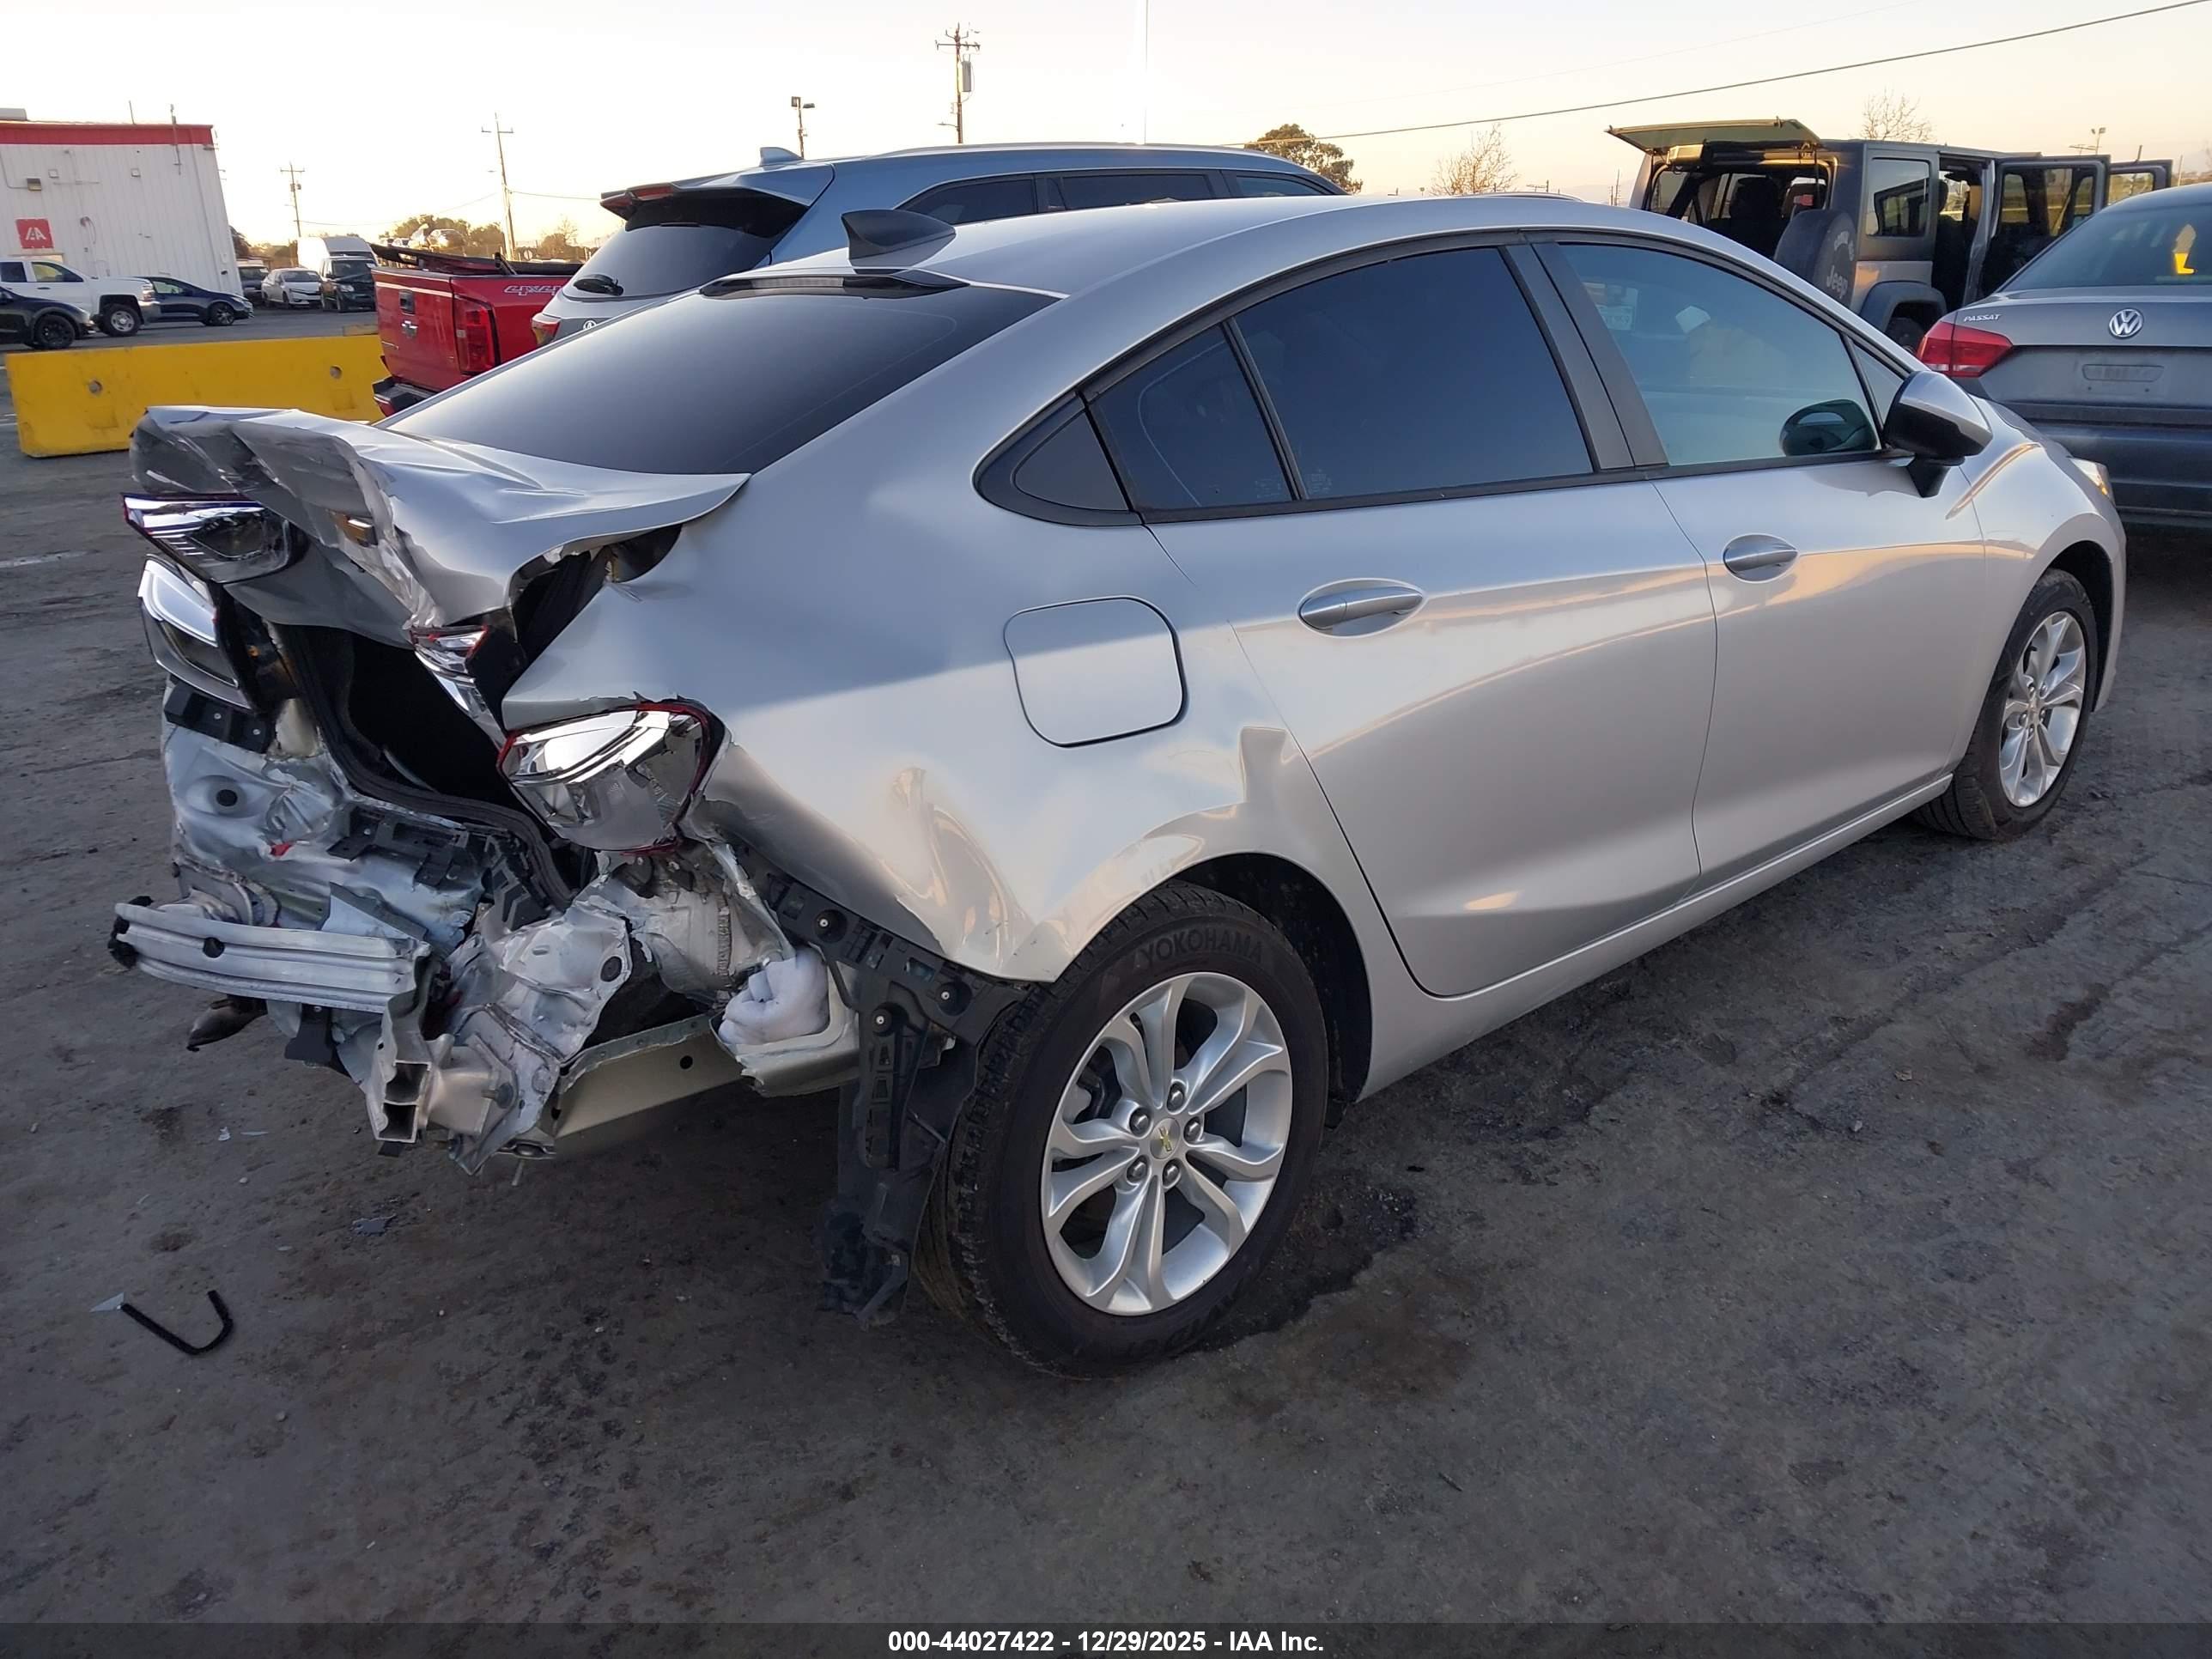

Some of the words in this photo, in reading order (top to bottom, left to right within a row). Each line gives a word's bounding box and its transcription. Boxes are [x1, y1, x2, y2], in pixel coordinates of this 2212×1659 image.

[1826, 264, 1849, 300] Jeep
[1963, 313, 2002, 322] PASSAT
[2109, 308, 2144, 338] VW
[1139, 928, 1264, 967] YOKOHAMA
